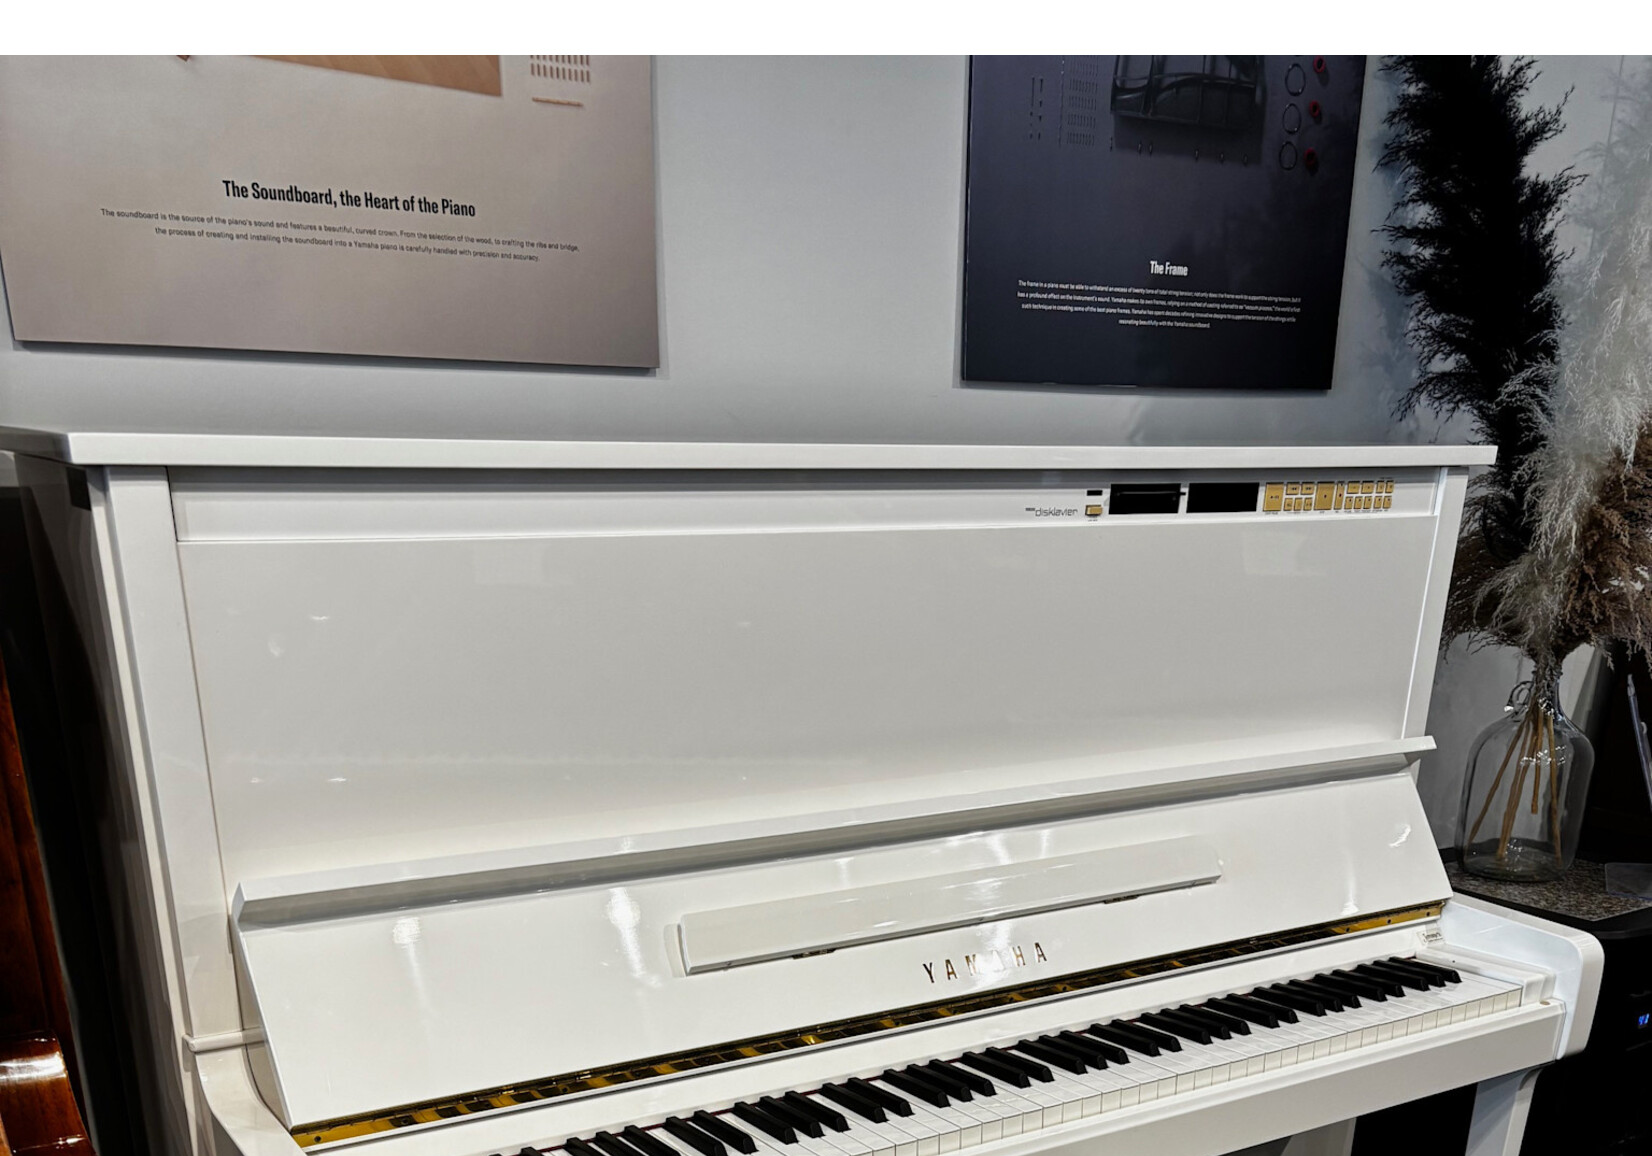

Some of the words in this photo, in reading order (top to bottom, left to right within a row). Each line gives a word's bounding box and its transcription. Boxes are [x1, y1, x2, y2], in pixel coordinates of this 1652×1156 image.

[222, 180, 249, 199] The
[251, 182, 338, 208] Soundboard,
[339, 190, 362, 208] the
[364, 191, 400, 211] Heart
[402, 196, 416, 212] of
[418, 198, 439, 214] the
[441, 198, 476, 217] Piano
[101, 208, 115, 216] The
[117, 210, 159, 220] soundboard
[169, 213, 180, 221] the
[228, 218, 253, 226] piano's
[290, 222, 317, 231] features
[400, 230, 416, 239] From
[418, 232, 428, 240] the
[429, 233, 456, 242] selection
[155, 226, 167, 234] the
[206, 231, 234, 240] creating
[250, 233, 281, 244] installing
[295, 237, 333, 246] soundboard
[353, 240, 379, 249] Yamaha
[380, 243, 398, 251] piano
[406, 245, 432, 254] carefully
[433, 246, 457, 255] handled
[1150, 260, 1164, 275] The
[1164, 261, 1188, 276] Frame
[1035, 507, 1078, 516] disklavier
